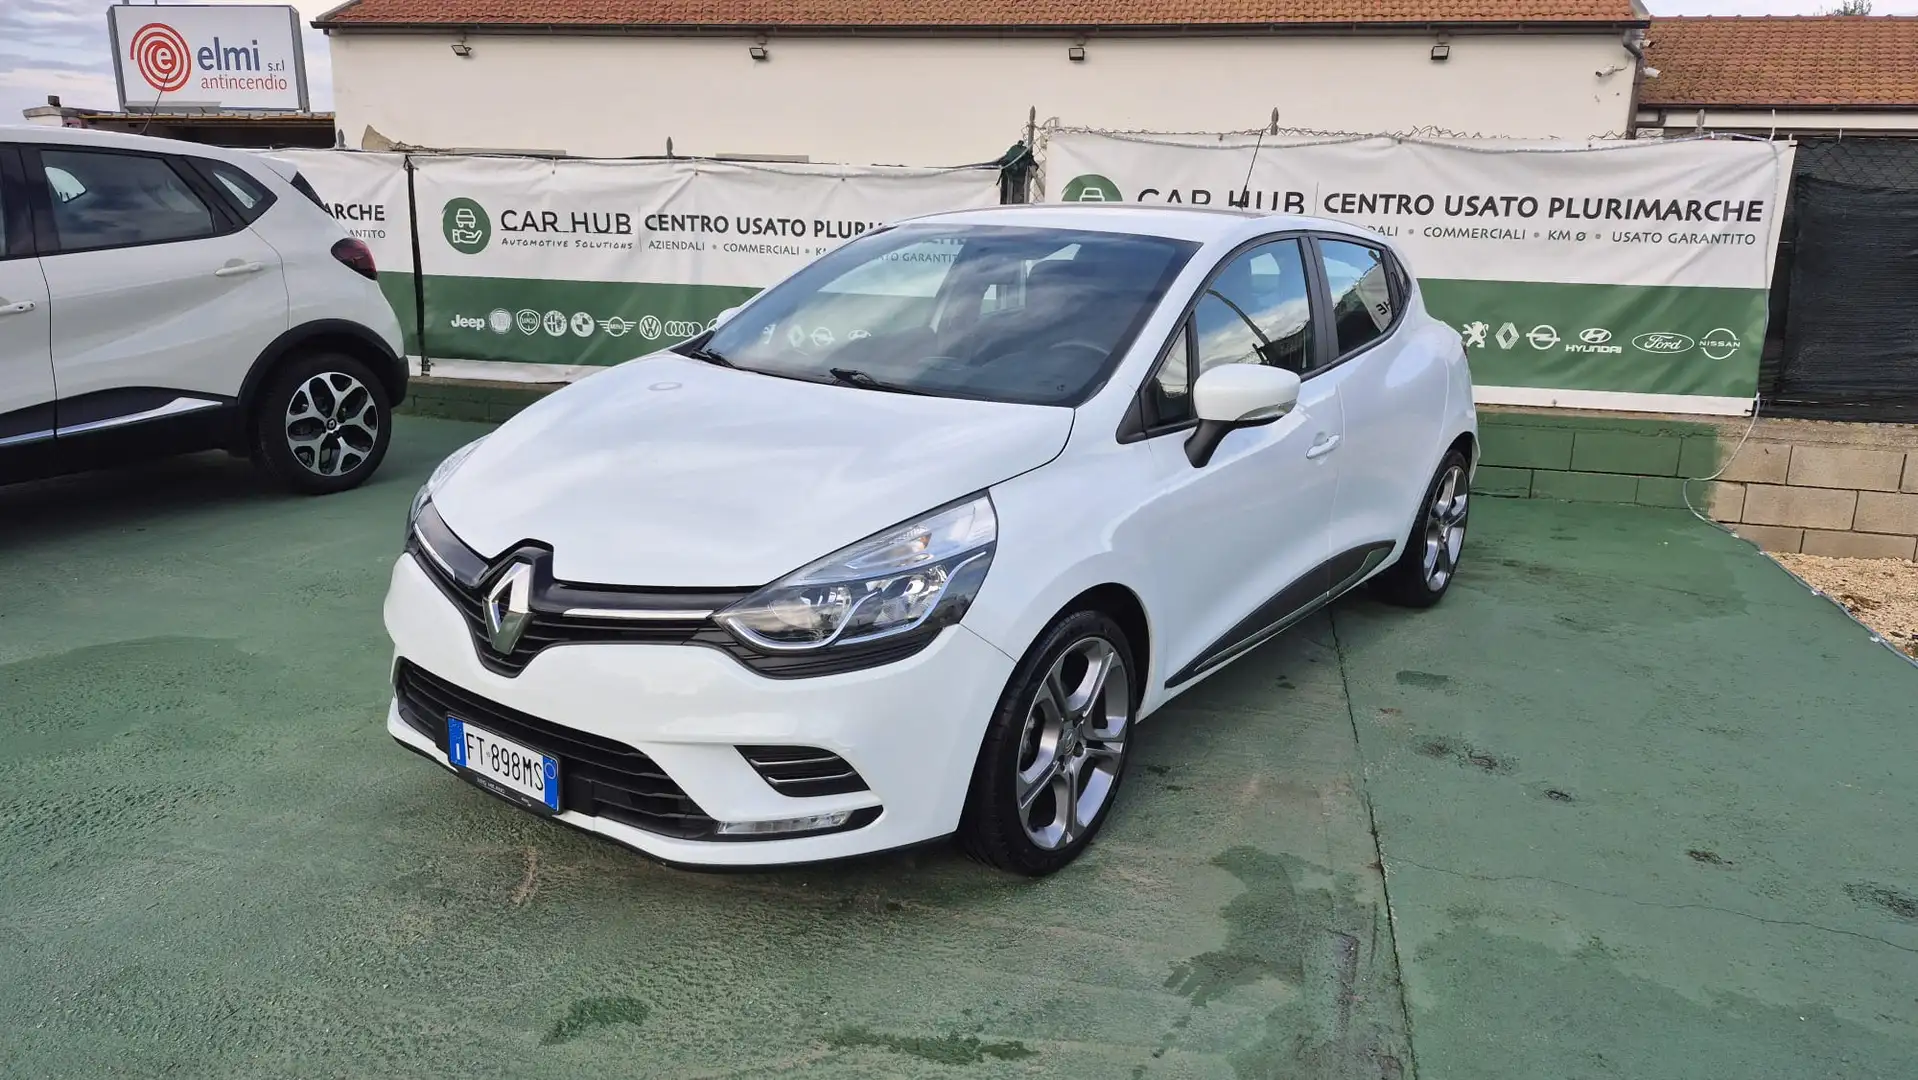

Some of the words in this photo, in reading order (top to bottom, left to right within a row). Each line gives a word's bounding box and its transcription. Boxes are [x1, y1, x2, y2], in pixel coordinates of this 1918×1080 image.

[197, 36, 260, 71] elmi
[201, 74, 288, 91] antincendio
[1324, 193, 1435, 216] CENTRO
[1444, 195, 1539, 218] USATO
[1548, 197, 1764, 222] PLURIMARCHE
[500, 209, 560, 232] CAR
[570, 211, 633, 234] HUB
[644, 214, 730, 234] CENTRO
[736, 216, 806, 237] USATO
[813, 220, 884, 239] PLUR
[1423, 226, 1526, 240] COMMERCIALI
[1547, 230, 1571, 241] KM
[1612, 231, 1663, 244] USATO
[1668, 232, 1756, 245] GARANTITO
[648, 240, 705, 251] AZIENDALI
[723, 242, 800, 256] COMMERCIALI
[450, 314, 485, 331] Jeep
[1565, 344, 1622, 354] HYUNDAI
[1644, 334, 1682, 351] Ford
[1699, 340, 1741, 348] NISSAN
[465, 732, 485, 766] FT
[490, 743, 544, 791] 898MS
